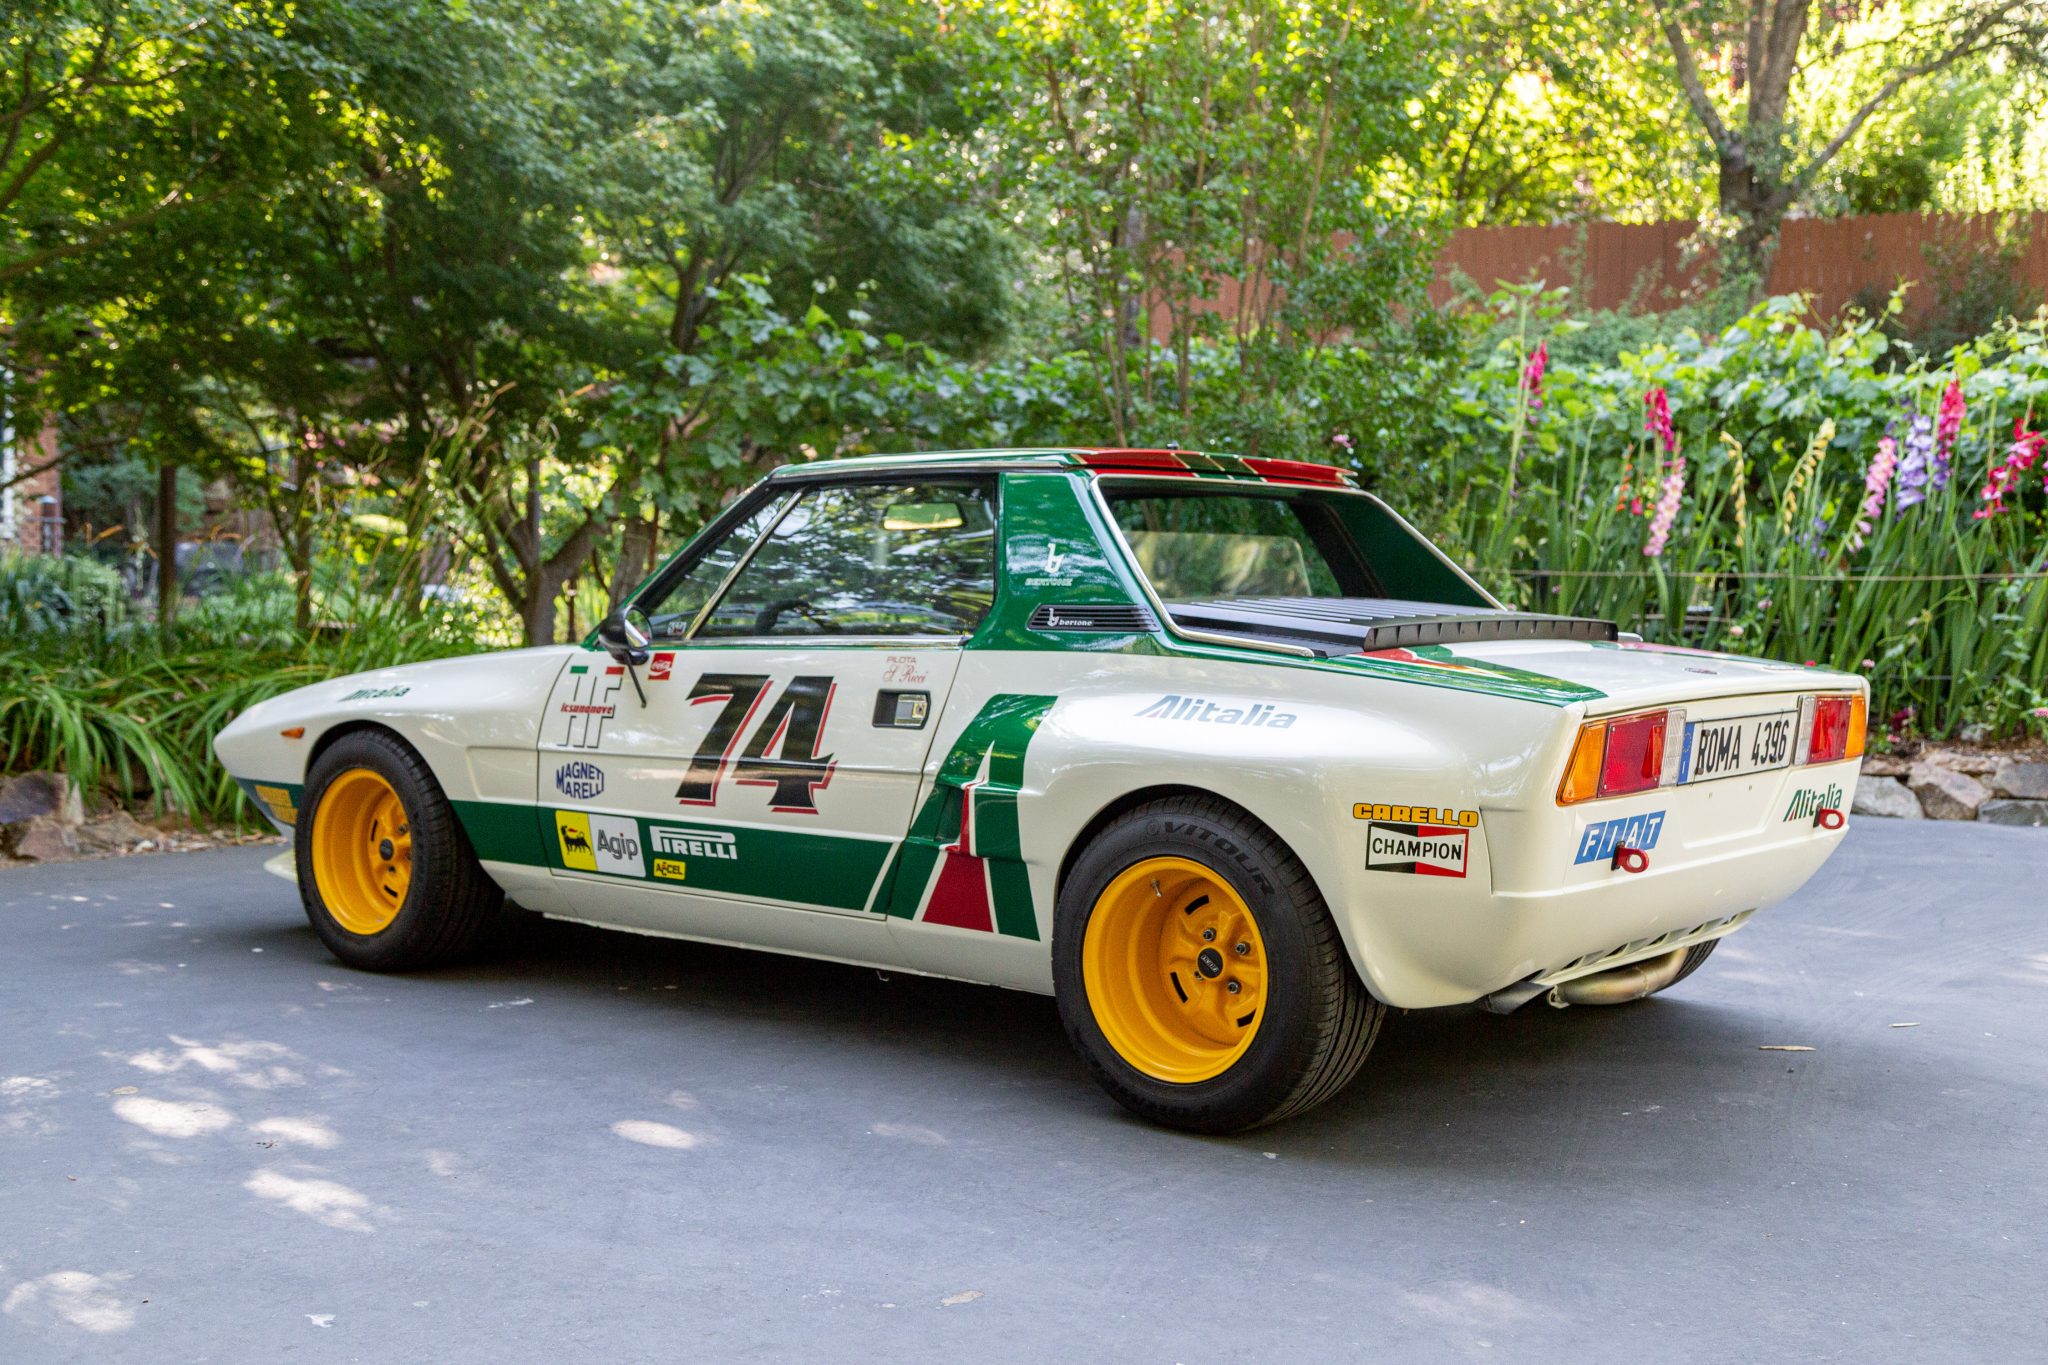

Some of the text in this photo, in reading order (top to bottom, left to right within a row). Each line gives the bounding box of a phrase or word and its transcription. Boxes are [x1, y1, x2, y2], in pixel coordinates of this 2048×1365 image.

[1133, 694, 1298, 730] Alitalia
[675, 673, 839, 815] 74
[1695, 719, 1790, 775] ROMA 4396
[1352, 802, 1480, 828] CARELLO
[1783, 783, 1843, 823] Alitalia
[597, 828, 639, 861] Agip
[649, 825, 738, 860] PIRELLI
[1372, 838, 1463, 861] CHAMPION
[1579, 814, 1663, 861] FIAT
[1164, 820, 1276, 896] VITOUR
